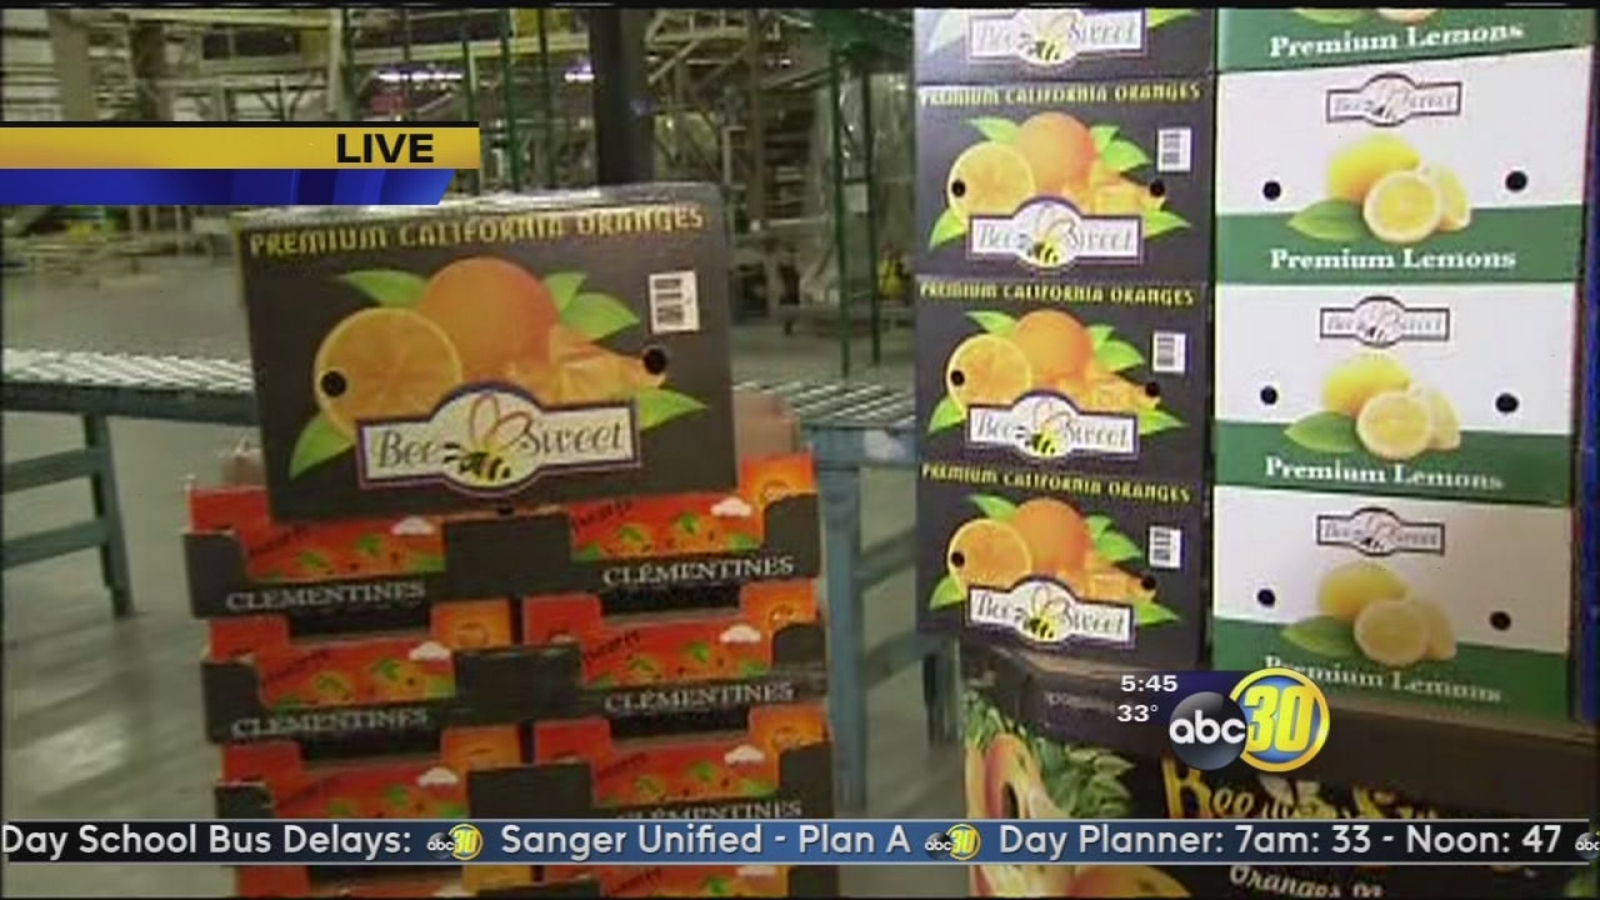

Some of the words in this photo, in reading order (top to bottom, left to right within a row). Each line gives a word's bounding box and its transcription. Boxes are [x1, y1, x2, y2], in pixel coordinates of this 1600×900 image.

[1269, 30, 1398, 58] Premium
[1407, 22, 1525, 48] Lemons
[1005, 85, 1107, 104] CALIFORNIA
[1114, 82, 1201, 101] ORANGES
[250, 229, 386, 257] PREMIUM
[400, 216, 564, 247] CALIFORNIA
[577, 206, 704, 235] ORANGES
[1270, 249, 1396, 269] Premium
[1403, 250, 1517, 269] Lemons
[920, 282, 997, 299] PREMIUM
[1003, 284, 1102, 302] CALIFORNIA
[1110, 288, 1194, 306] ORANGES
[376, 426, 437, 468] Bee
[519, 417, 624, 455] Sweet
[921, 462, 997, 484] PREMIUM
[1003, 472, 1102, 494] CALIFORNIA
[1108, 480, 1191, 503] ORANGES
[1265, 455, 1386, 484] Premium
[1394, 464, 1504, 490] Lemons
[1264, 655, 1384, 687] Pemium
[1393, 670, 1502, 702] Lemons
